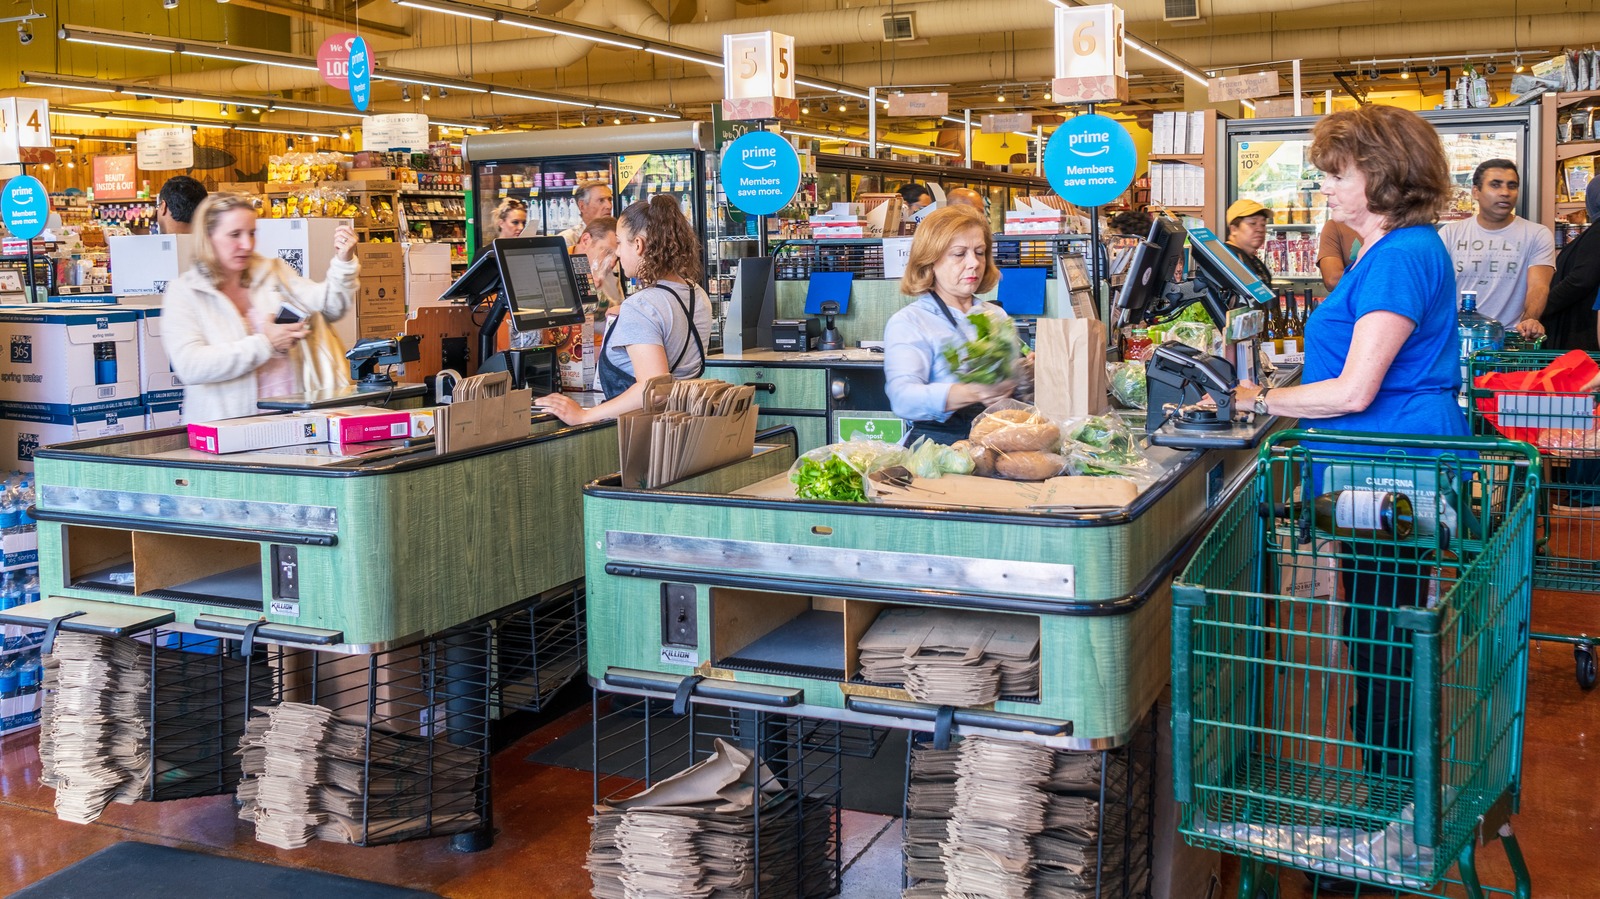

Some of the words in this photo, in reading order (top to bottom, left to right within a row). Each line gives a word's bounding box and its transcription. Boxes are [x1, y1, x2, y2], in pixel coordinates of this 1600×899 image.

[1072, 20, 1096, 57] 6
[330, 44, 343, 52] We
[352, 51, 365, 68] prime
[740, 47, 757, 79] 5
[780, 48, 789, 79] 5
[326, 61, 349, 76] LOC
[1218, 81, 1242, 90] Frozen
[1244, 77, 1269, 88] Yogurt
[1236, 86, 1259, 94] Sorbet
[26, 109, 41, 132] 4
[1069, 131, 1110, 147] prime
[742, 146, 777, 161] prime
[1241, 159, 1259, 169] 10%
[1066, 165, 1114, 176] Members
[104, 174, 126, 182] BEAUTY
[740, 177, 781, 186] Members
[1063, 179, 1087, 187] save
[1088, 176, 1116, 186] more.
[96, 182, 116, 191] INSIDE
[738, 188, 761, 197] save
[763, 187, 783, 195] more.
[12, 187, 33, 198] prime
[1457, 240, 1521, 252] HOLLI
[1456, 261, 1518, 274] STER
[14, 344, 29, 358] 365
[1, 373, 21, 384] spring
[23, 374, 43, 383] water
[1366, 477, 1415, 488] CALIFORNIA
[18, 553, 36, 562] spring
[661, 649, 690, 661] KILLION
[15, 715, 33, 724] spring
